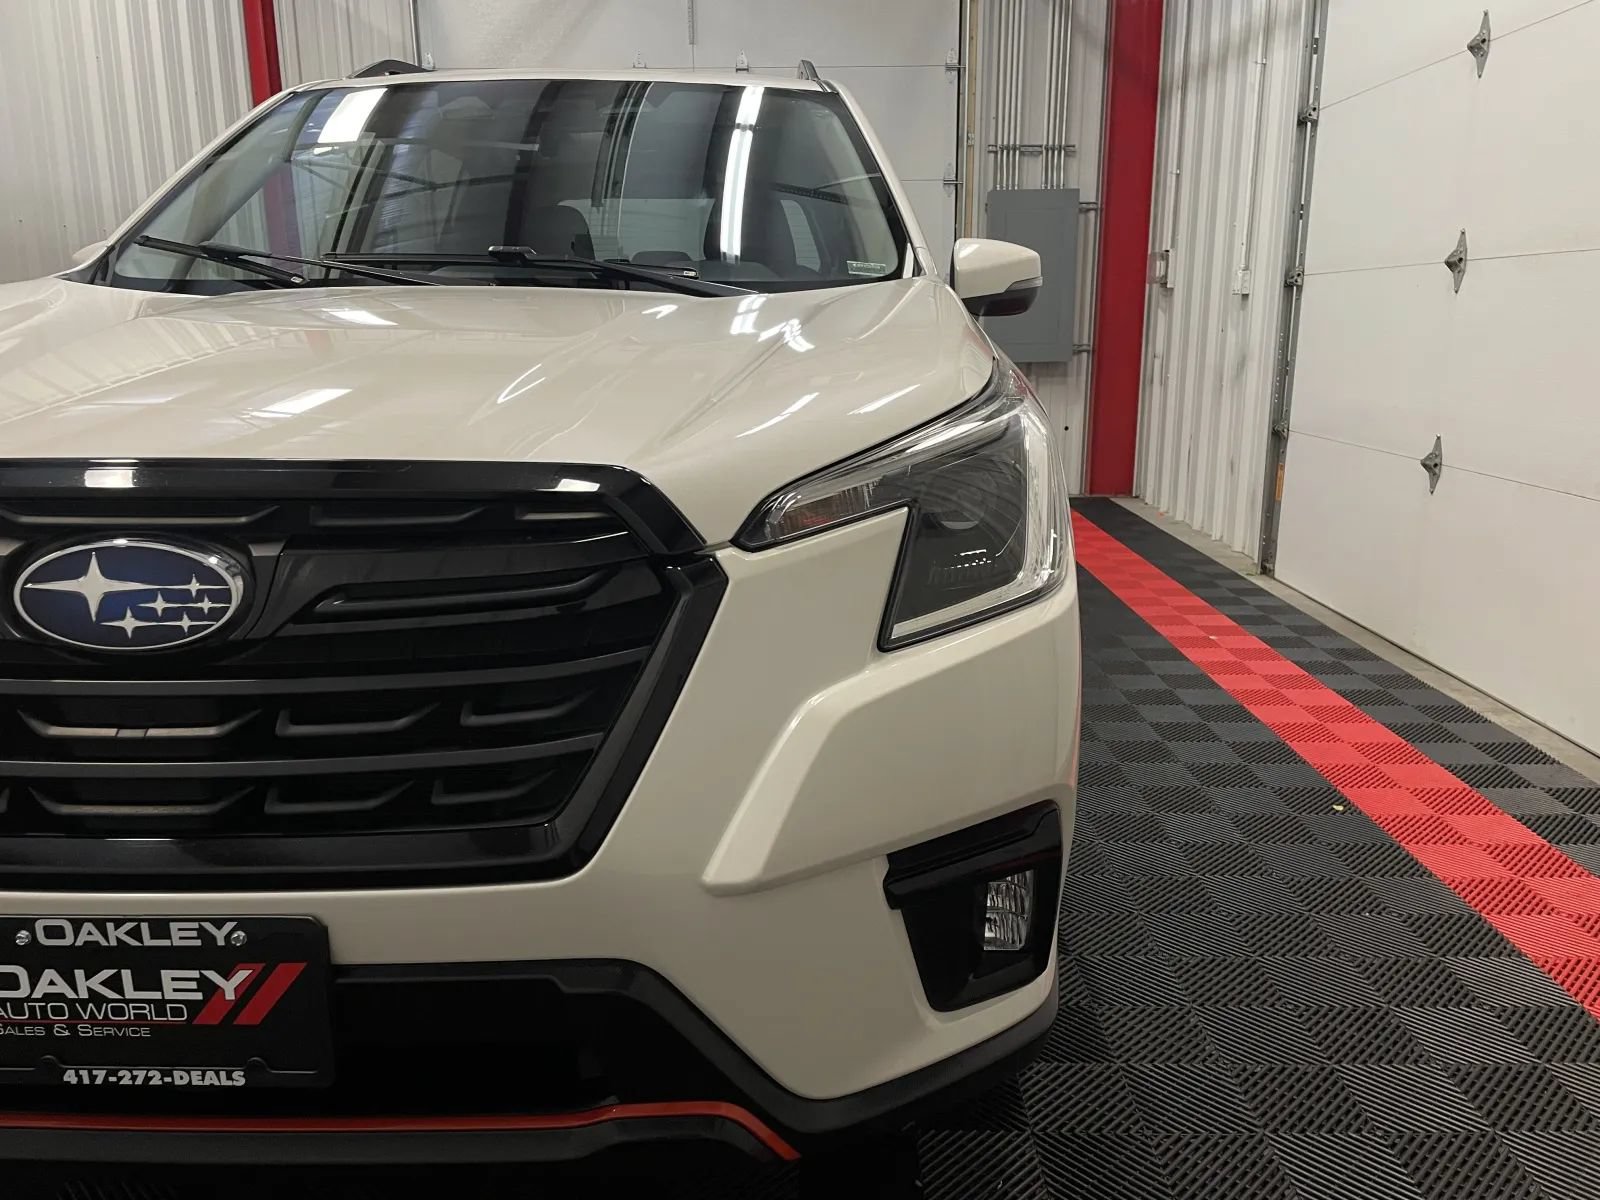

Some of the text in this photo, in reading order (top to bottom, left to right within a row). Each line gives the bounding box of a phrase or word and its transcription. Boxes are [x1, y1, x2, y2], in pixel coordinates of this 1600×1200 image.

[34, 918, 238, 946] OAKLEY
[76, 1003, 187, 1020] WORLD
[0, 1024, 45, 1035] ALES
[54, 1024, 70, 1036] &
[63, 1070, 246, 1086] 417-272-DEALS
